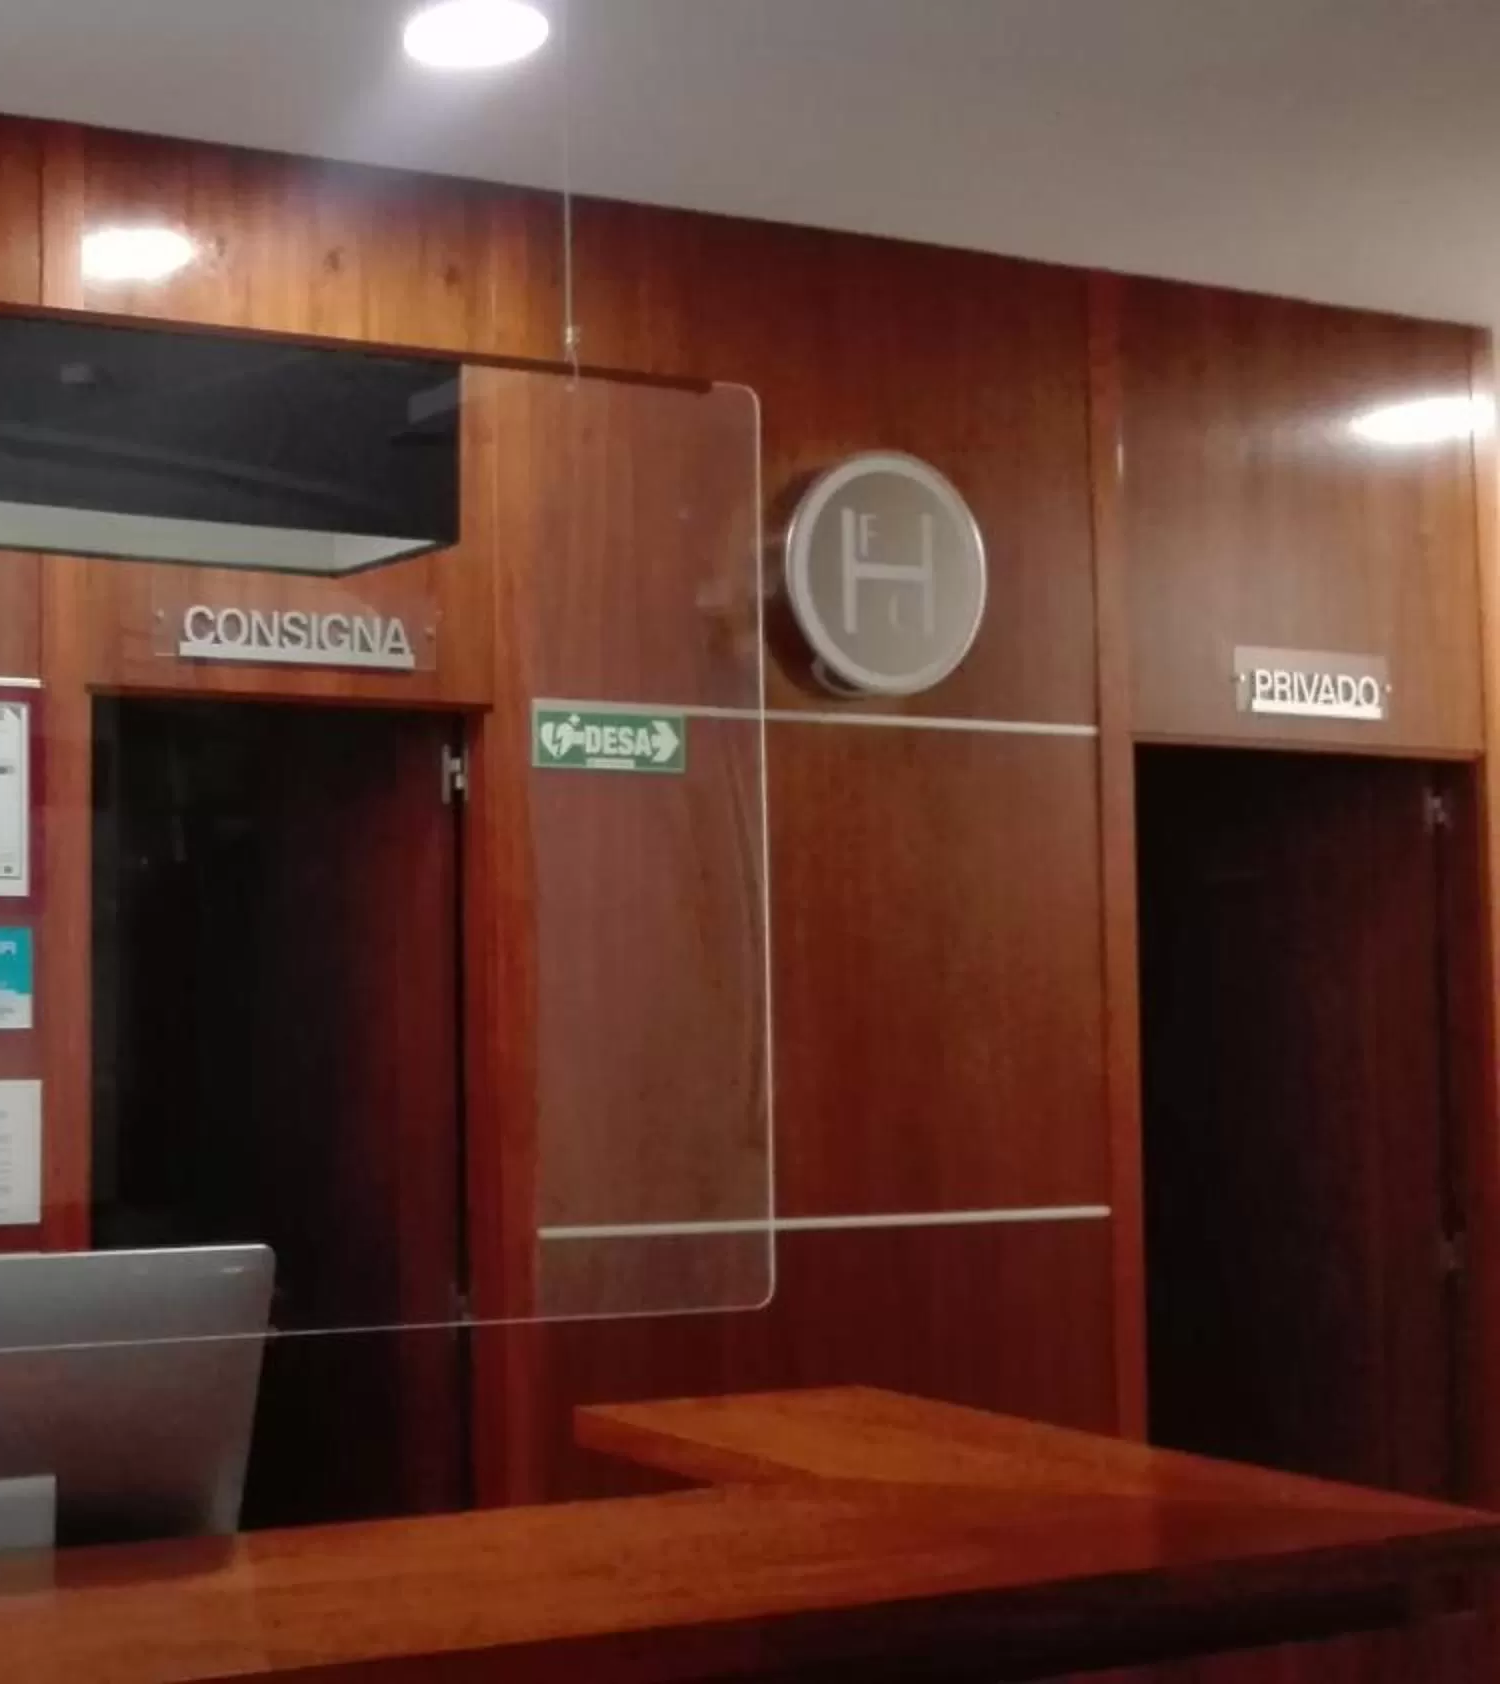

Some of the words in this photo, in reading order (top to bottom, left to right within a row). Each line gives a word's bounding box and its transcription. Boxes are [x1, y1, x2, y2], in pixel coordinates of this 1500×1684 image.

[183, 604, 413, 657] CONSIGNA
[1254, 668, 1380, 708] PRIVADO
[583, 724, 653, 758] DESA
